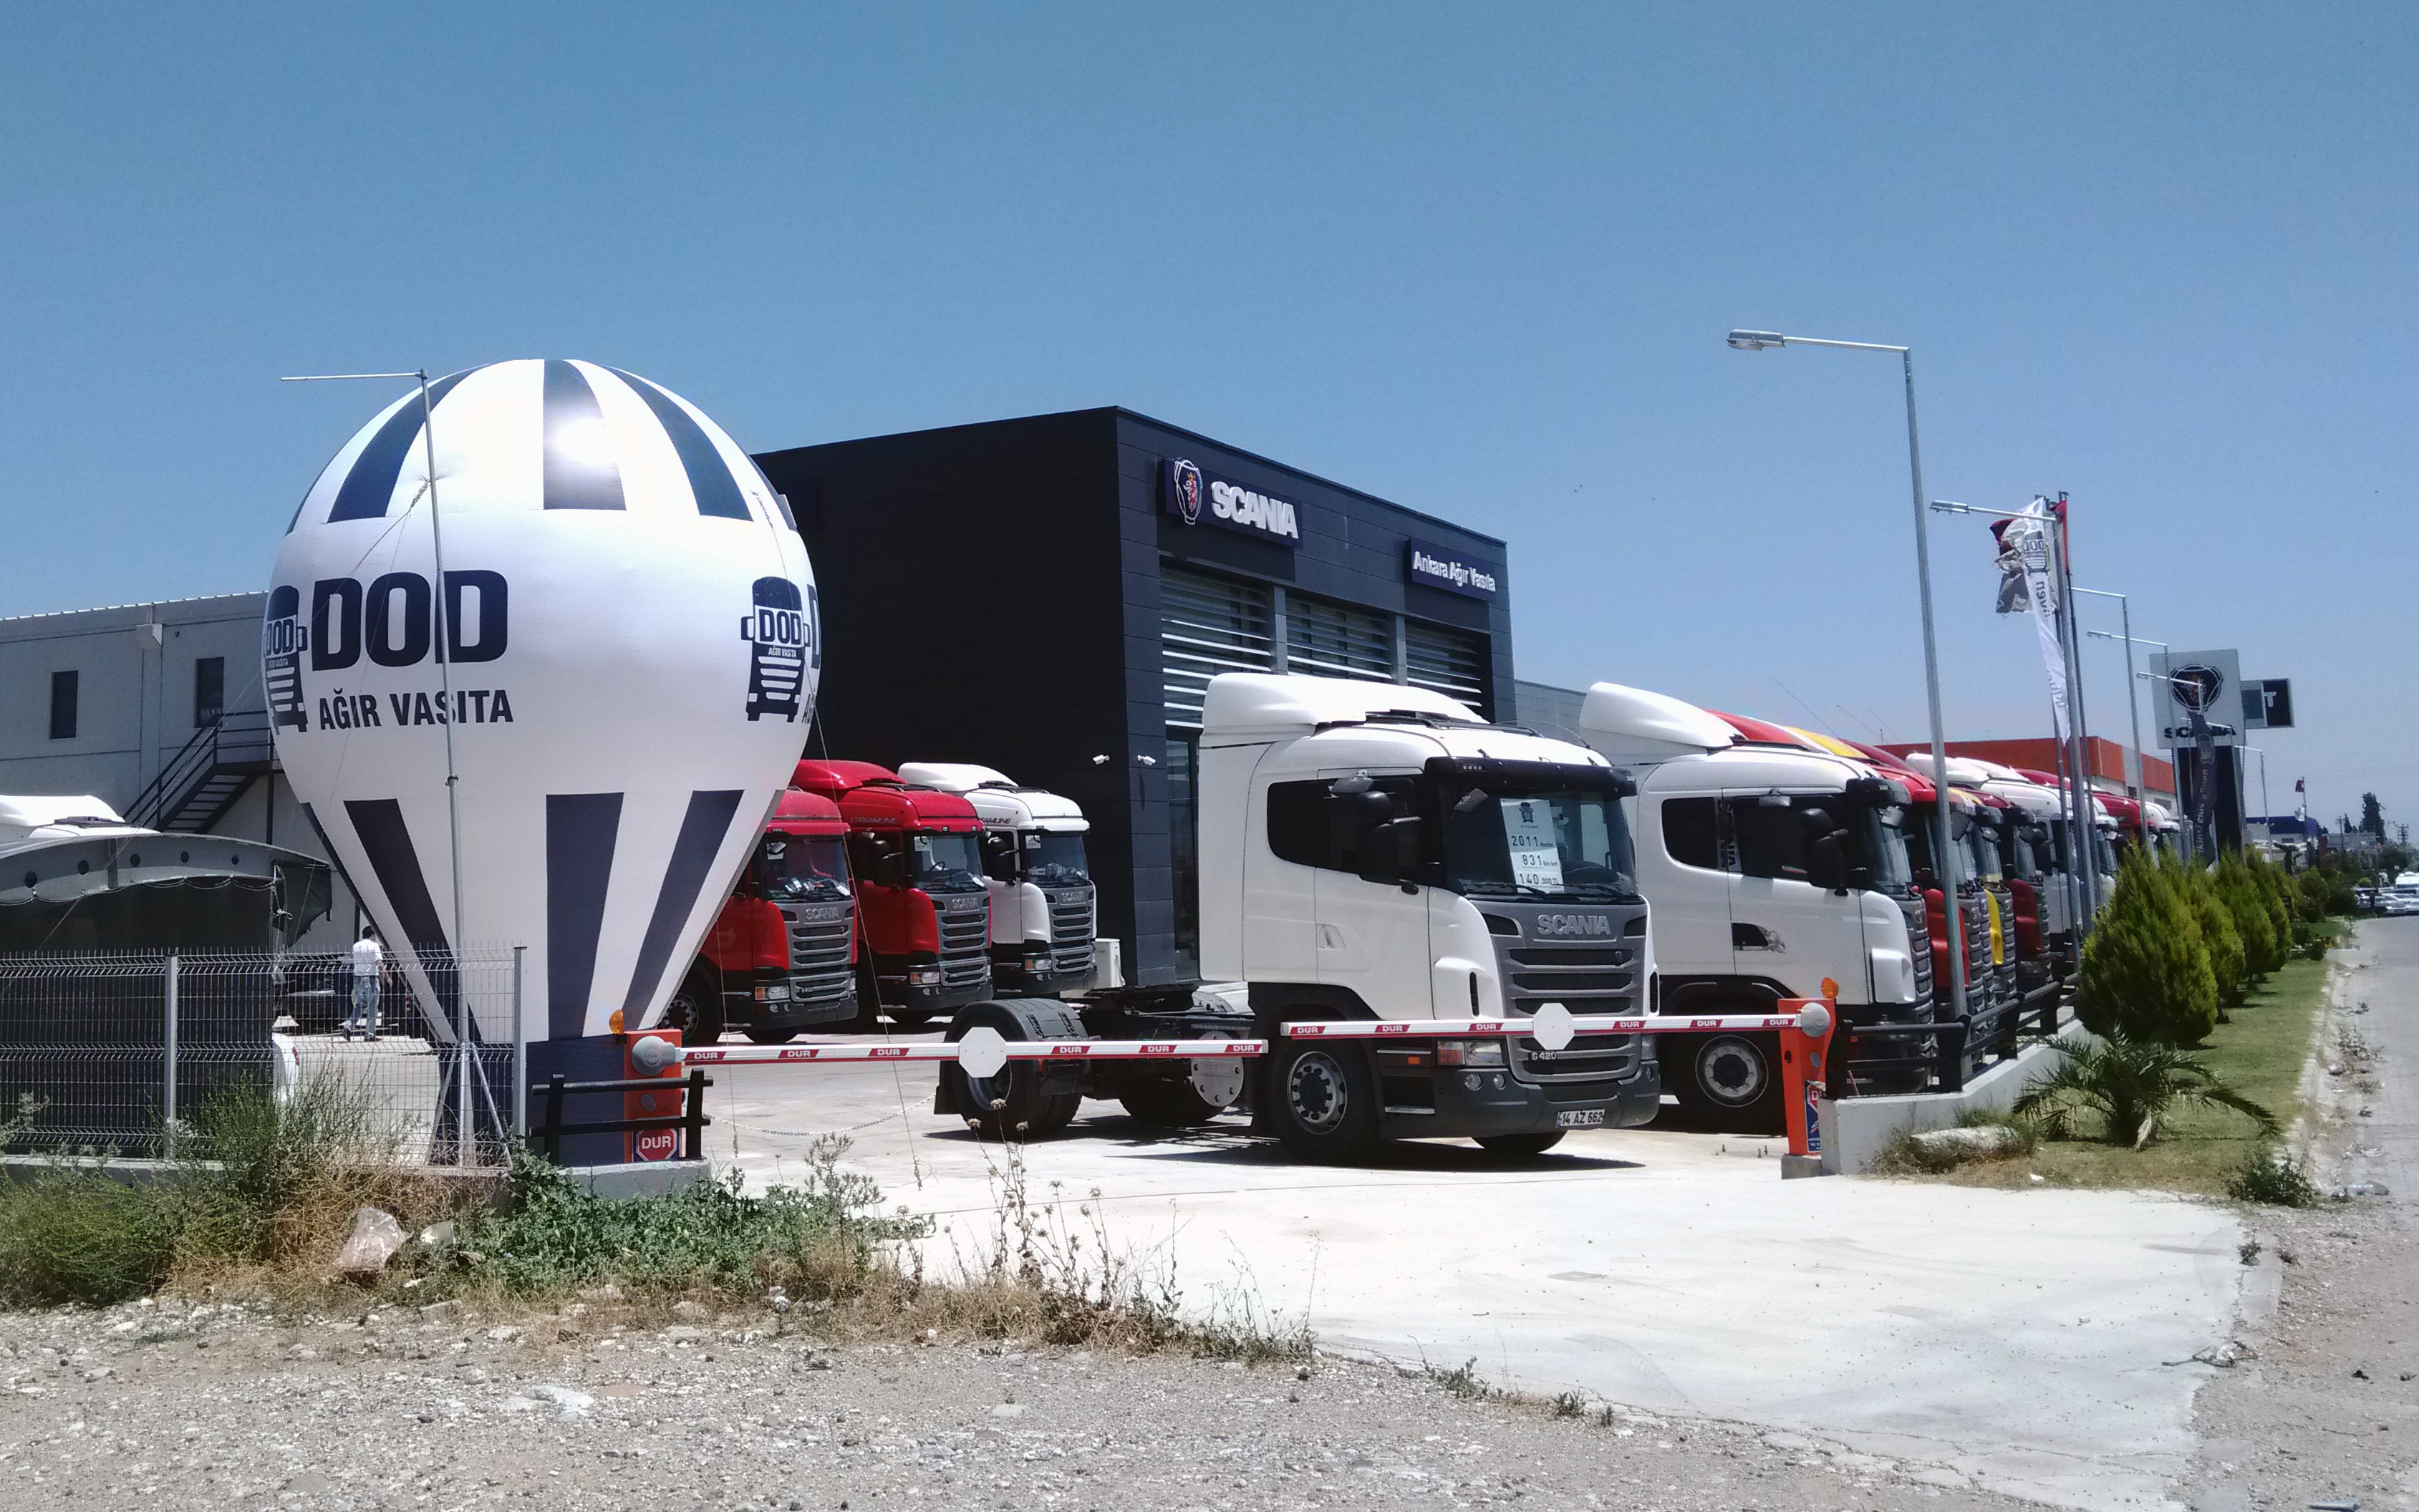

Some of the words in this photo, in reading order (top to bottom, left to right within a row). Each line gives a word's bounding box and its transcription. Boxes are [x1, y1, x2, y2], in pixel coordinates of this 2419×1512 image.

[1211, 481, 1298, 539] SCANIA
[1414, 551, 1448, 578] Ankara
[1449, 561, 1469, 587] Ağır
[1469, 567, 1496, 592] Vasıta
[312, 570, 508, 671] DOD
[759, 609, 802, 645] DOD
[319, 688, 382, 730] AĞIR
[390, 689, 514, 726] VASITA
[1511, 835, 1538, 848] 2011
[1522, 854, 1542, 866] 831
[1519, 873, 1539, 885] 140
[952, 897, 979, 909] SCANIA
[806, 907, 839, 920] SCANIA
[1537, 915, 1611, 935] SCANIA
[787, 1050, 811, 1058] DUR
[1532, 1052, 1557, 1060] G420
[1563, 1113, 1570, 1125] 14
[1573, 1112, 1585, 1124] AZ
[1588, 1111, 1603, 1123] 662
[642, 1137, 671, 1149] DUR
